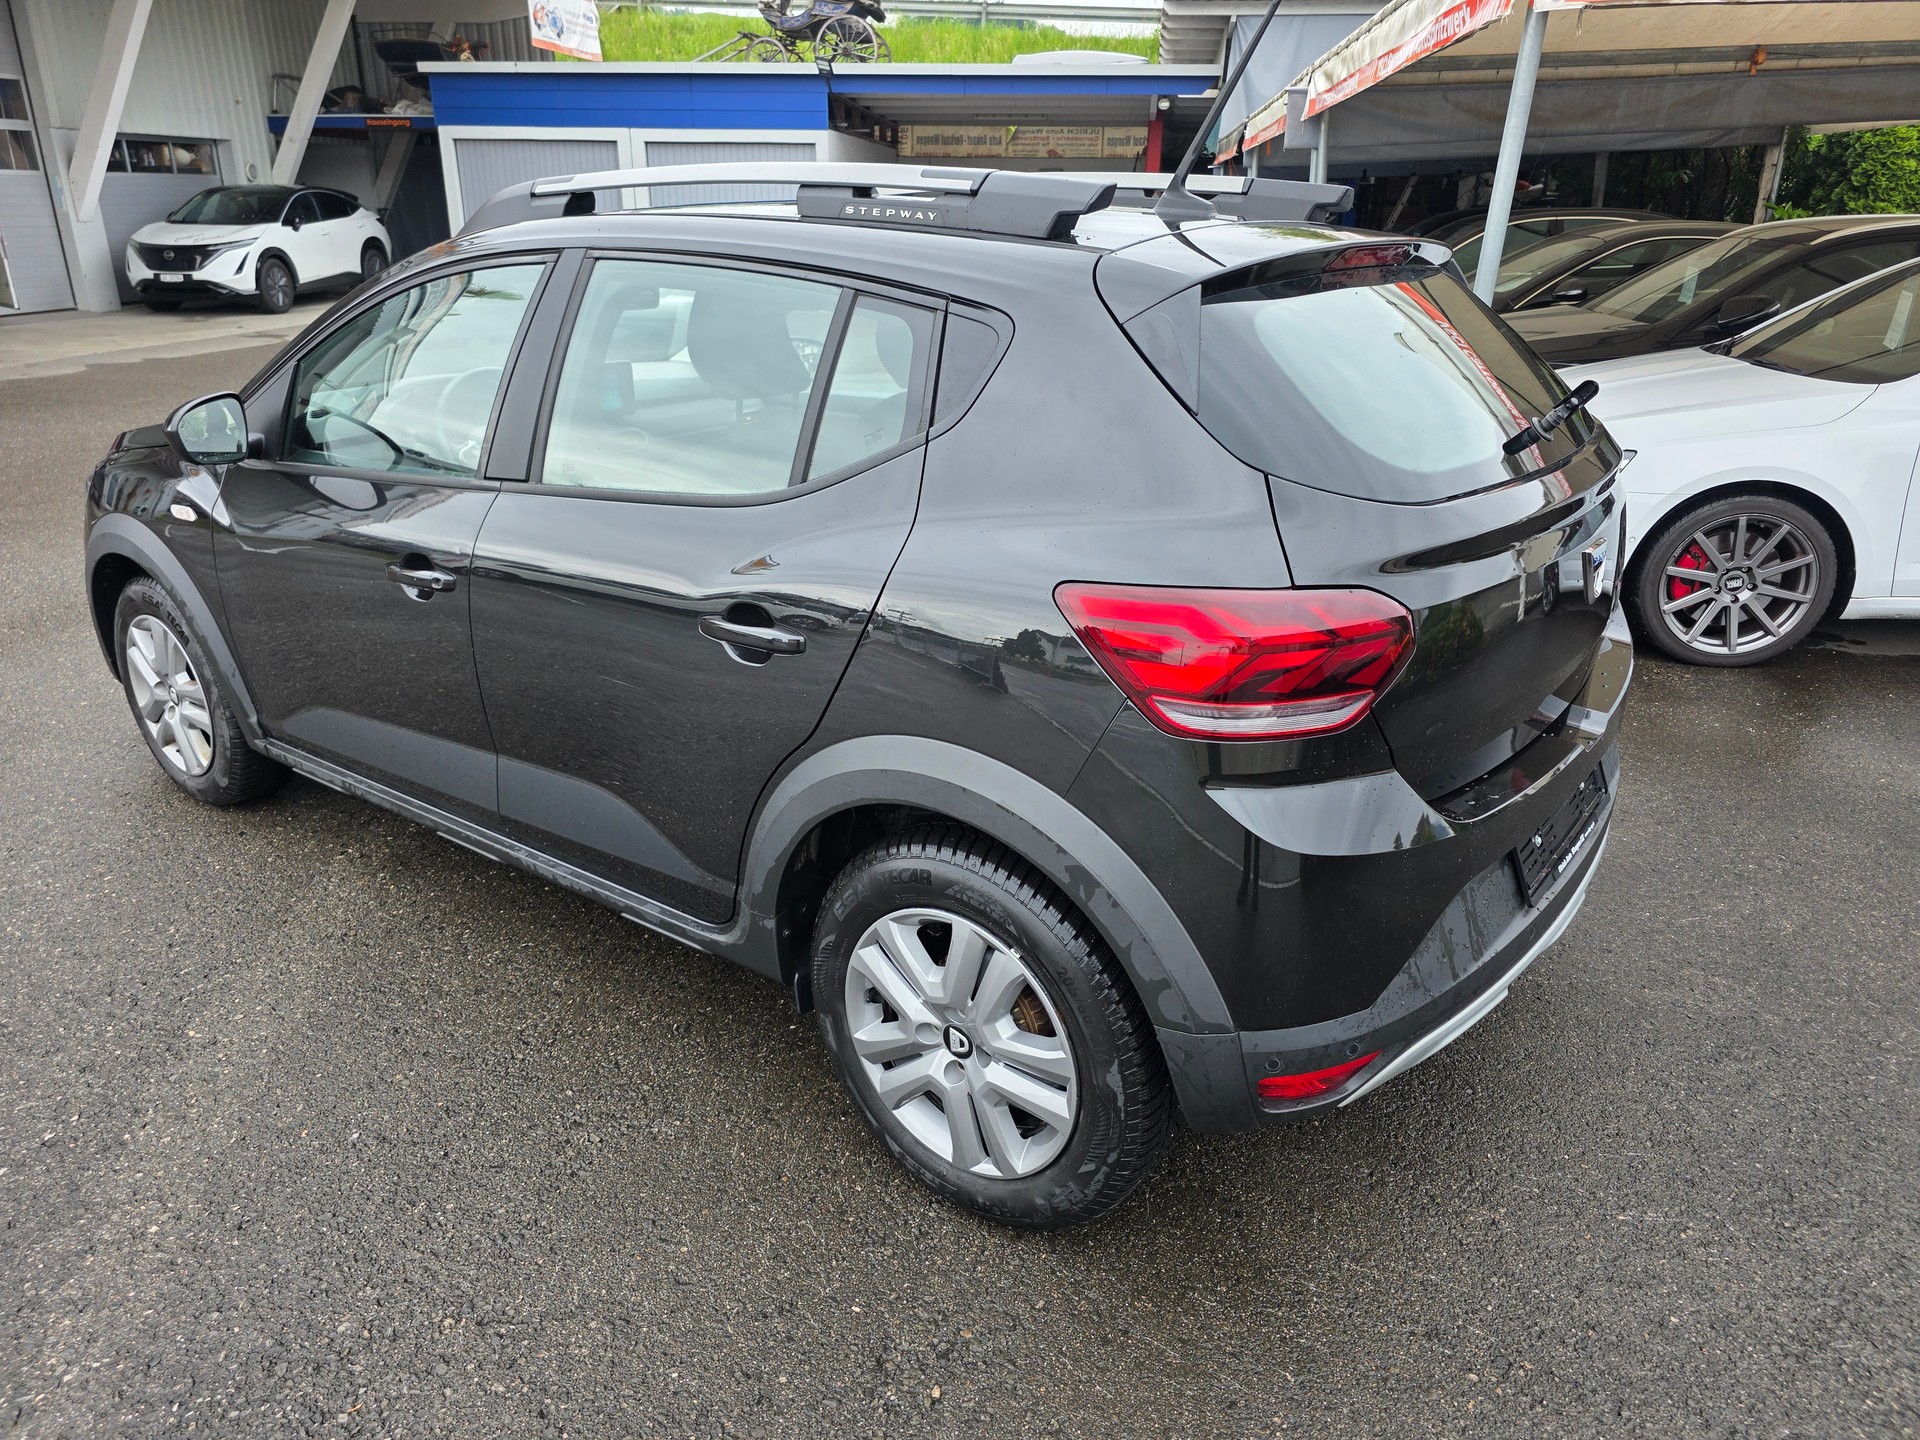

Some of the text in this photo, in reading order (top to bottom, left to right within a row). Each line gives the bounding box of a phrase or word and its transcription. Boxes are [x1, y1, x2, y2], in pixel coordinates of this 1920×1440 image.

[366, 118, 411, 127] Hauseingang
[844, 205, 939, 221] STEPWAY
[166, 609, 191, 647] TECAR
[877, 867, 933, 889] TECAR
